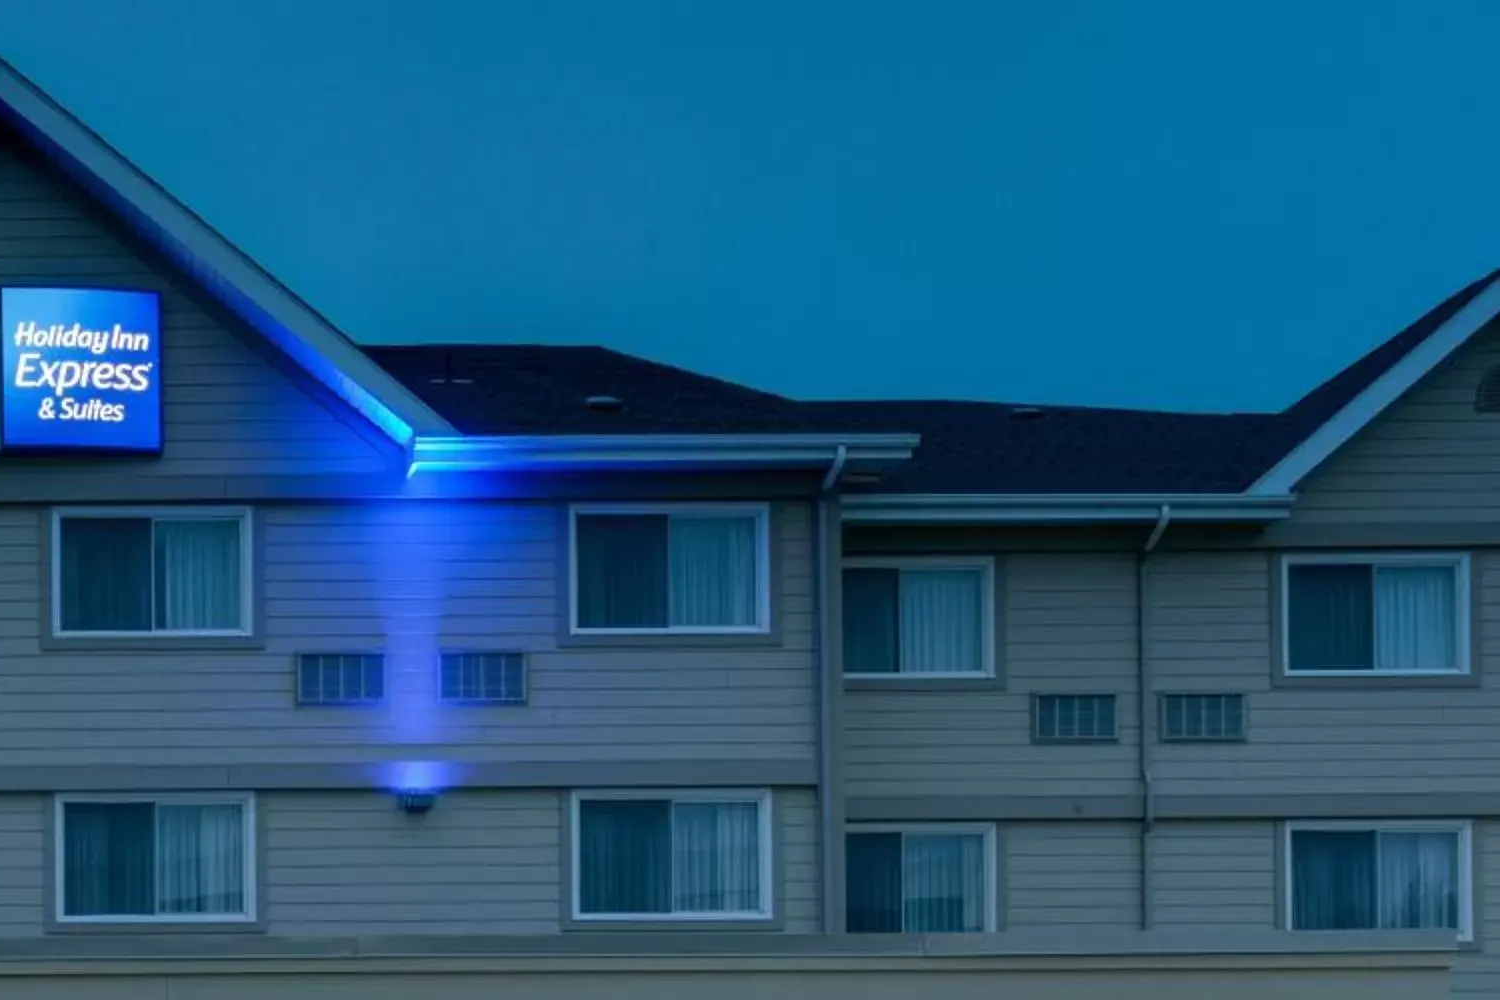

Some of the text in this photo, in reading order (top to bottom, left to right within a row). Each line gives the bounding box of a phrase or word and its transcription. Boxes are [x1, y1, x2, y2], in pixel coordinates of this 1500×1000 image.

[14, 321, 149, 354] Holiday Inn
[15, 352, 150, 396] Express
[37, 397, 125, 422] & Suites
